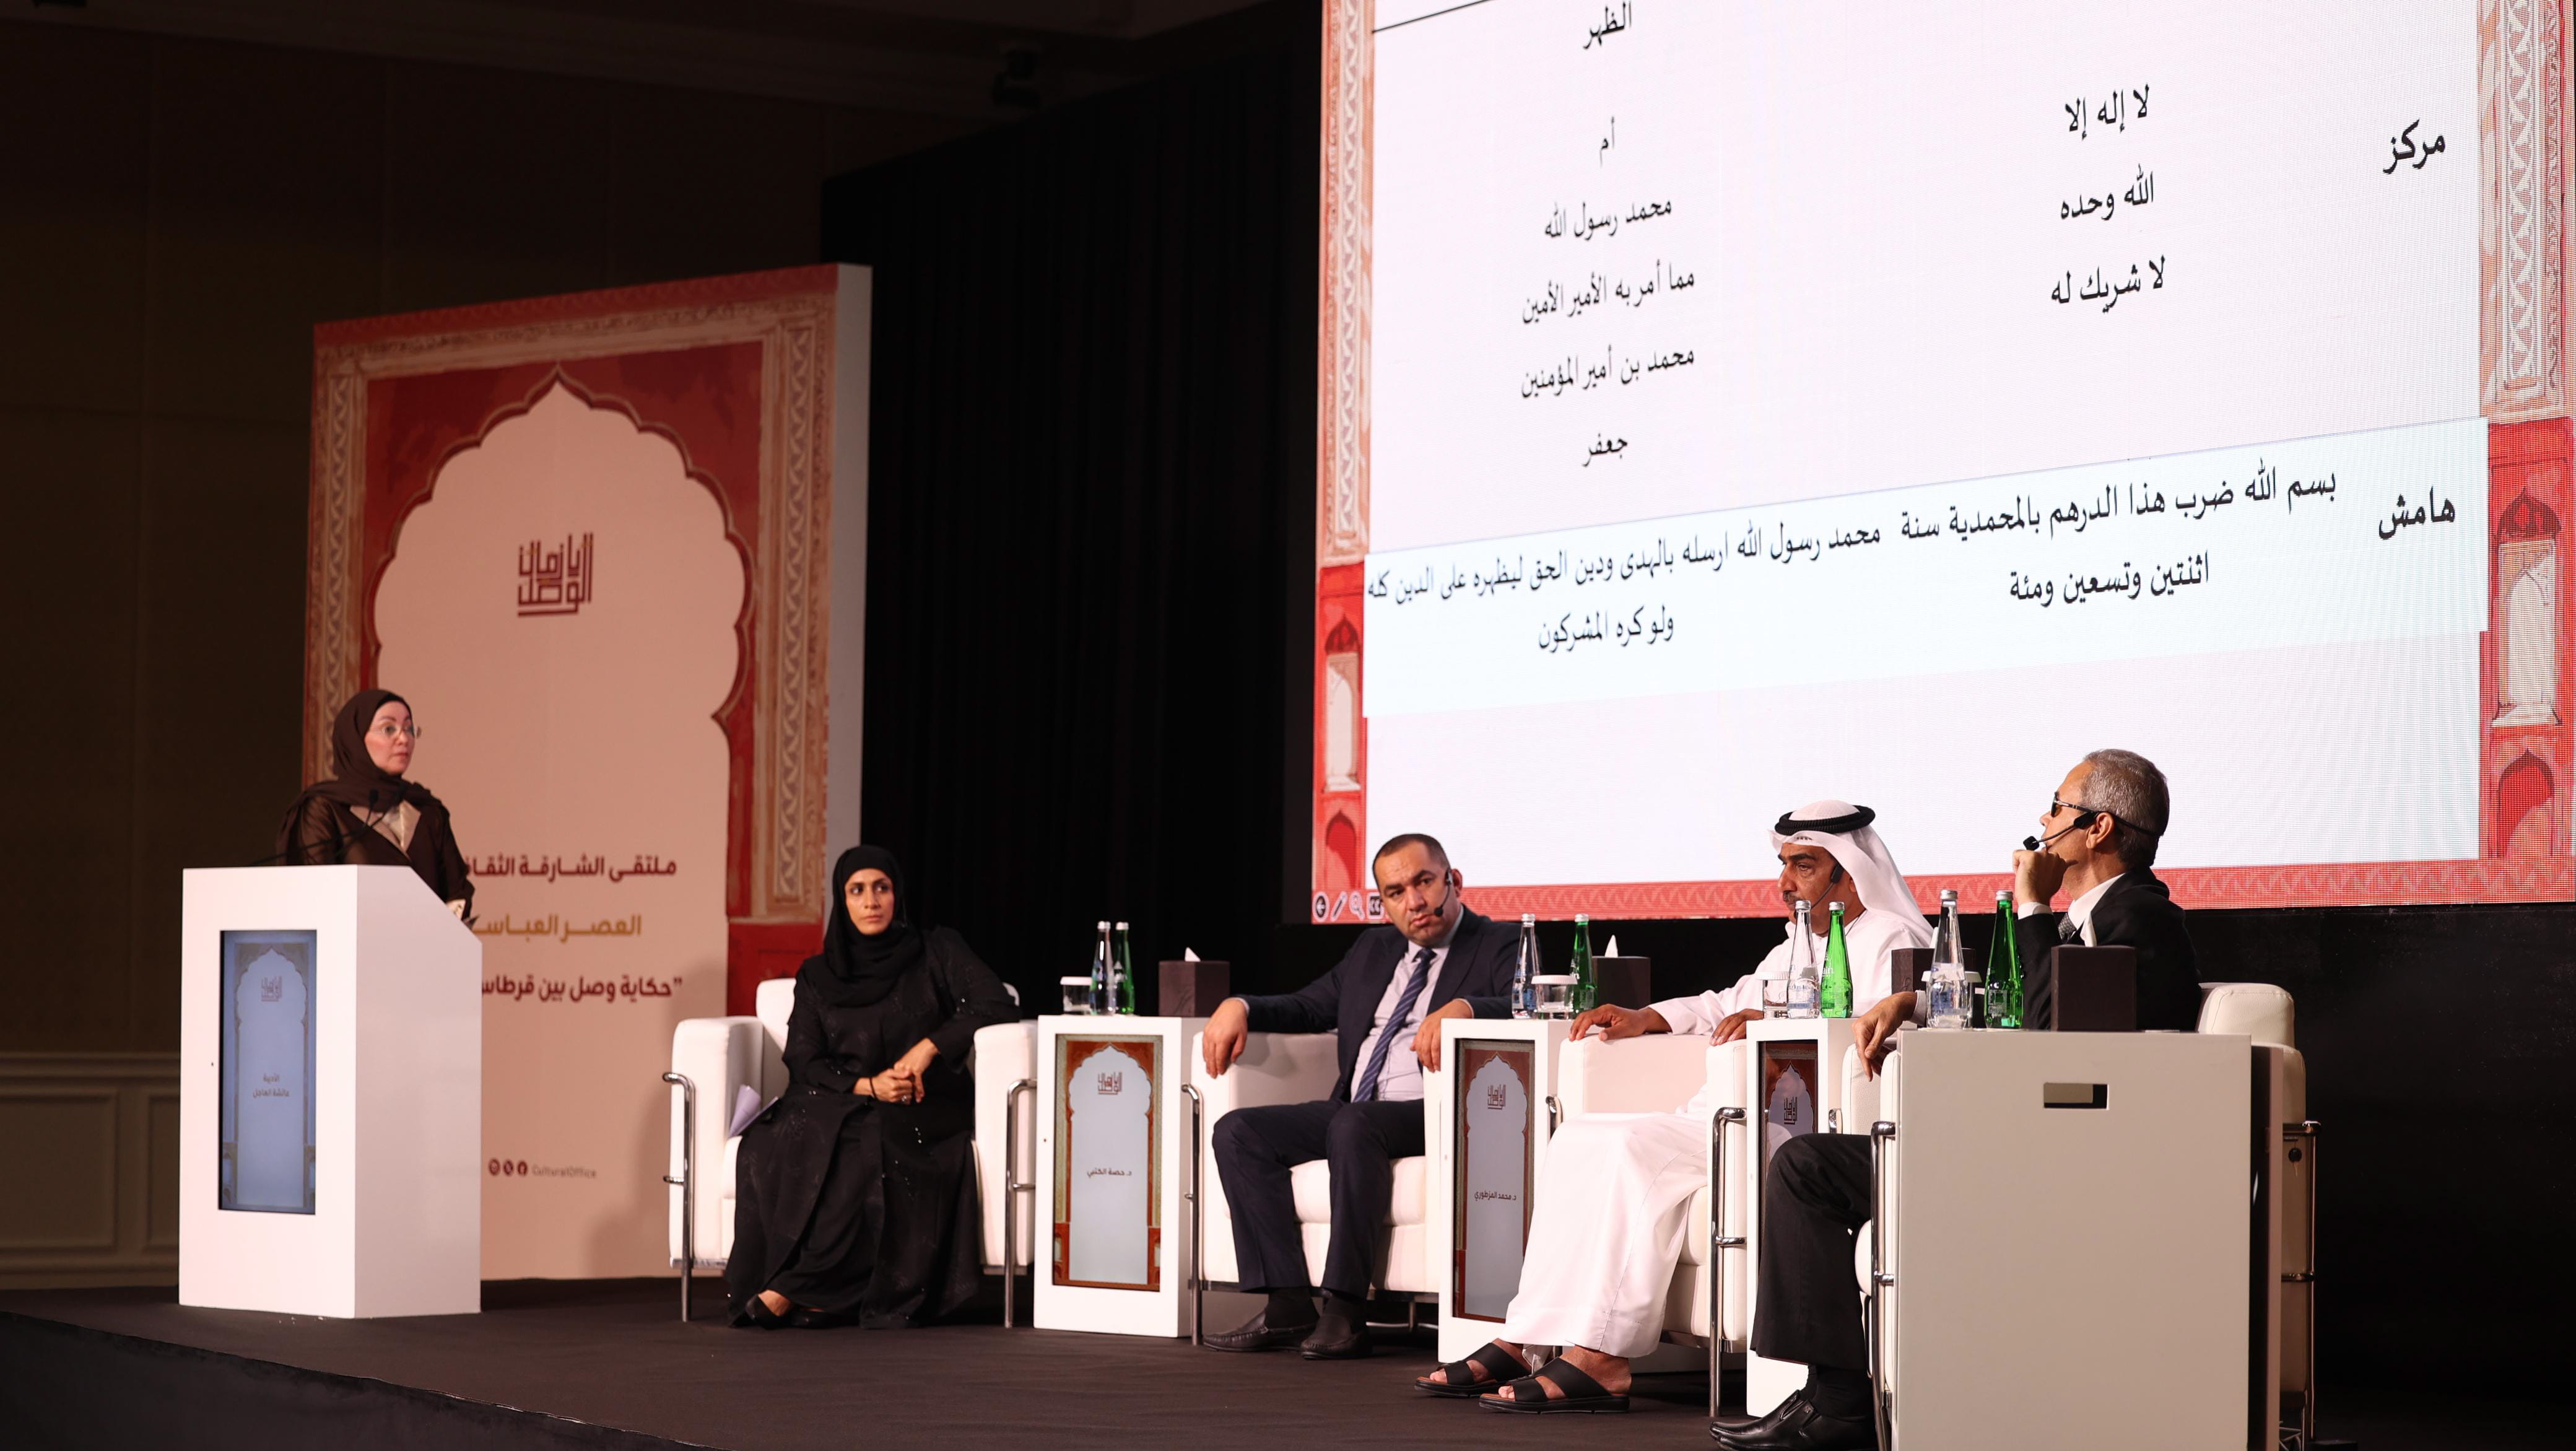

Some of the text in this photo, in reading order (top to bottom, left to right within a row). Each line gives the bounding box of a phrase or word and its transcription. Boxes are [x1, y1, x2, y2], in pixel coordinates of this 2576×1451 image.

[1582, 0, 1633, 51] الظهر
[2065, 84, 2150, 141] لا إله إلا
[1599, 115, 1616, 165] أم
[2382, 119, 2446, 175] مركز
[2060, 163, 2154, 222] الله وحده
[1544, 199, 1673, 242] محمد رسول الله
[1566, 271, 1608, 318] الأمير
[1668, 263, 1695, 291] مما
[2050, 255, 2166, 314] لا شريك له
[1521, 279, 1564, 326] الأمين
[1521, 344, 1695, 400] محمد بن أمير المؤمنين
[1581, 432, 1629, 469] جعفر
[1901, 458, 2336, 542] بسم الله ضرب هذا الدرهم بالمحمدية سنة
[2378, 486, 2456, 541] هامش
[1619, 538, 1674, 582] بالهدى
[1736, 520, 1762, 559] الله
[1769, 521, 1821, 565] رسول
[1827, 528, 1881, 550] محمد
[1367, 570, 1390, 599] كله
[1395, 566, 1434, 606] الدين
[1440, 567, 1467, 601] على
[1473, 554, 1523, 598] ليظهره
[1529, 549, 1567, 592] الحق
[1574, 556, 1614, 587] ودين
[2009, 551, 2209, 608] اثنتين وتسعين ومئة
[1538, 604, 1674, 655] ولو كره المشركون
[466, 852, 677, 884] ملتقى الشارقة الثقا
[472, 913, 642, 944] العصر العباس
[538, 976, 566, 1002] بين
[569, 975, 616, 1003] وصل
